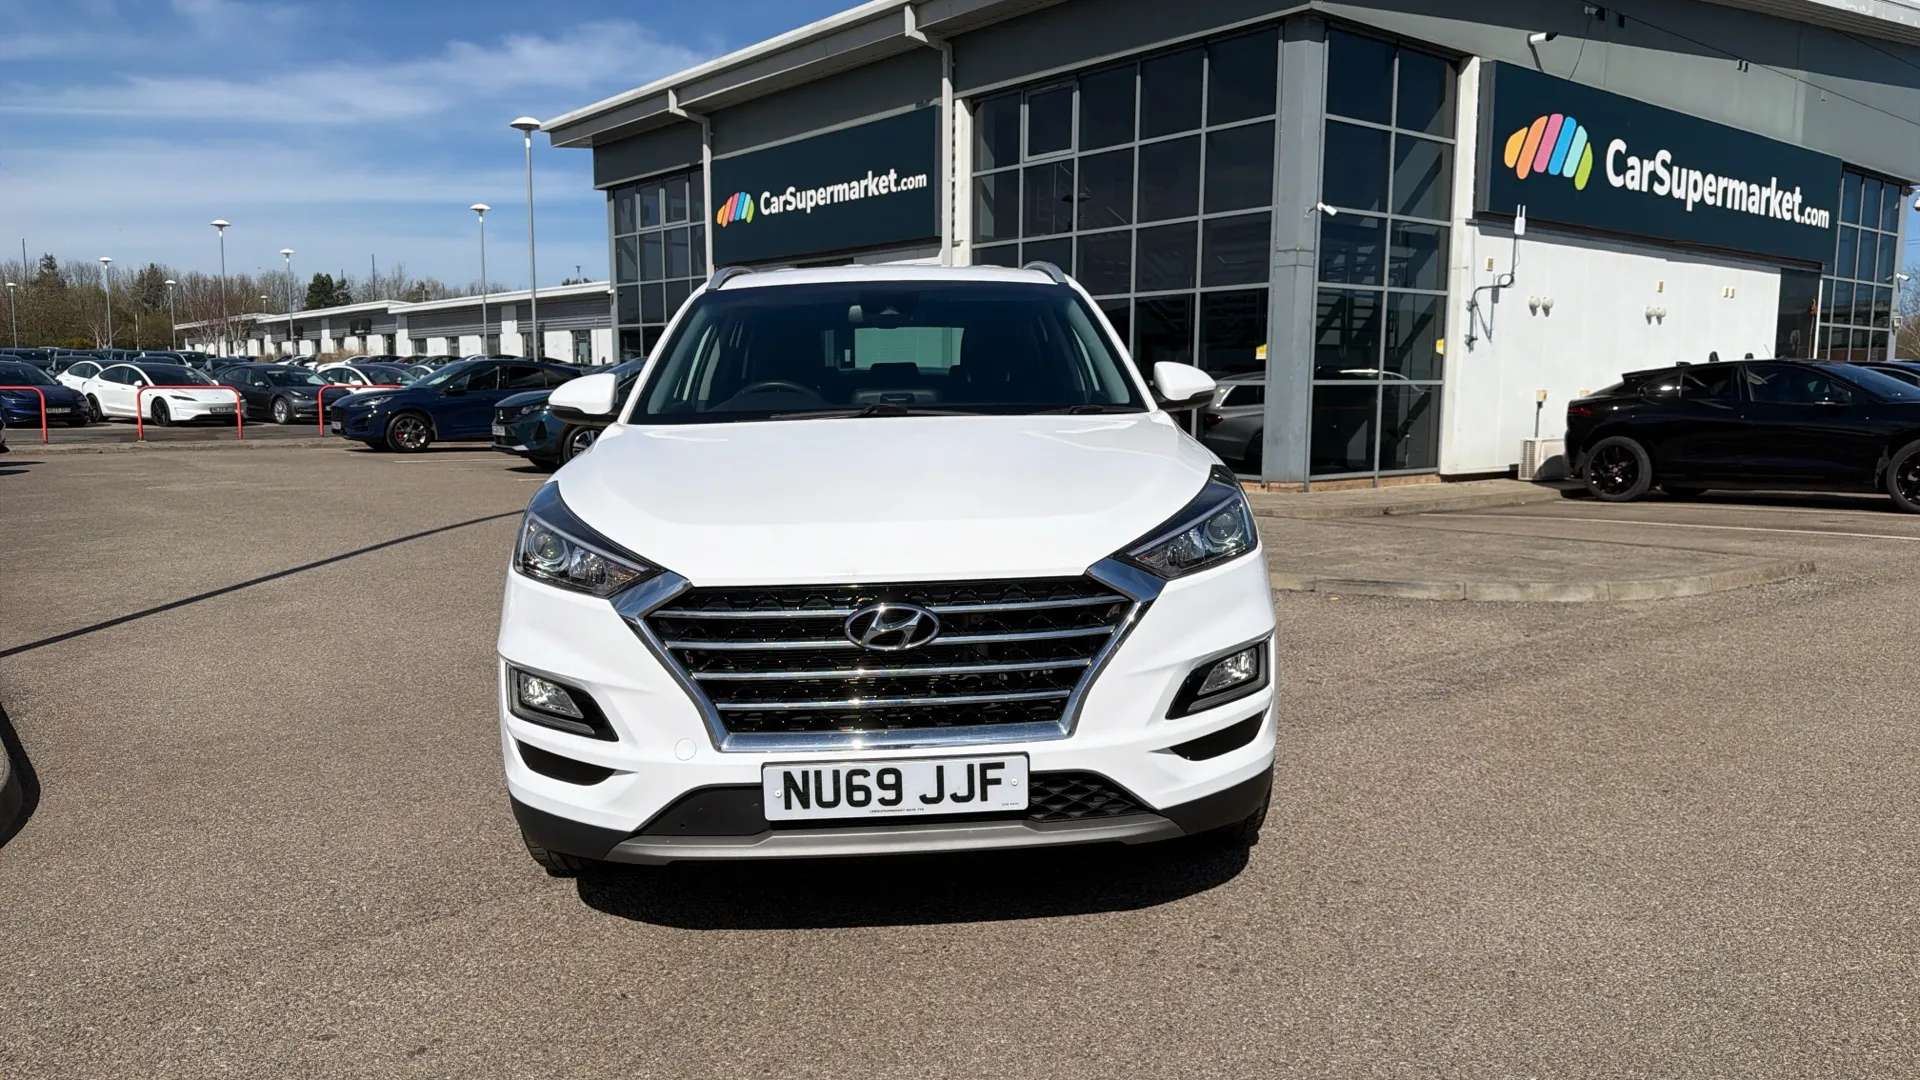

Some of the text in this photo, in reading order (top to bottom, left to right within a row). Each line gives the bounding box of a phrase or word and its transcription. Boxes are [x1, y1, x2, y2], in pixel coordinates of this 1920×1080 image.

[760, 169, 927, 215] CarSupermarket.com
[1606, 139, 1830, 229] CarSupermarket.com
[783, 762, 1005, 811] NU69 JJF
